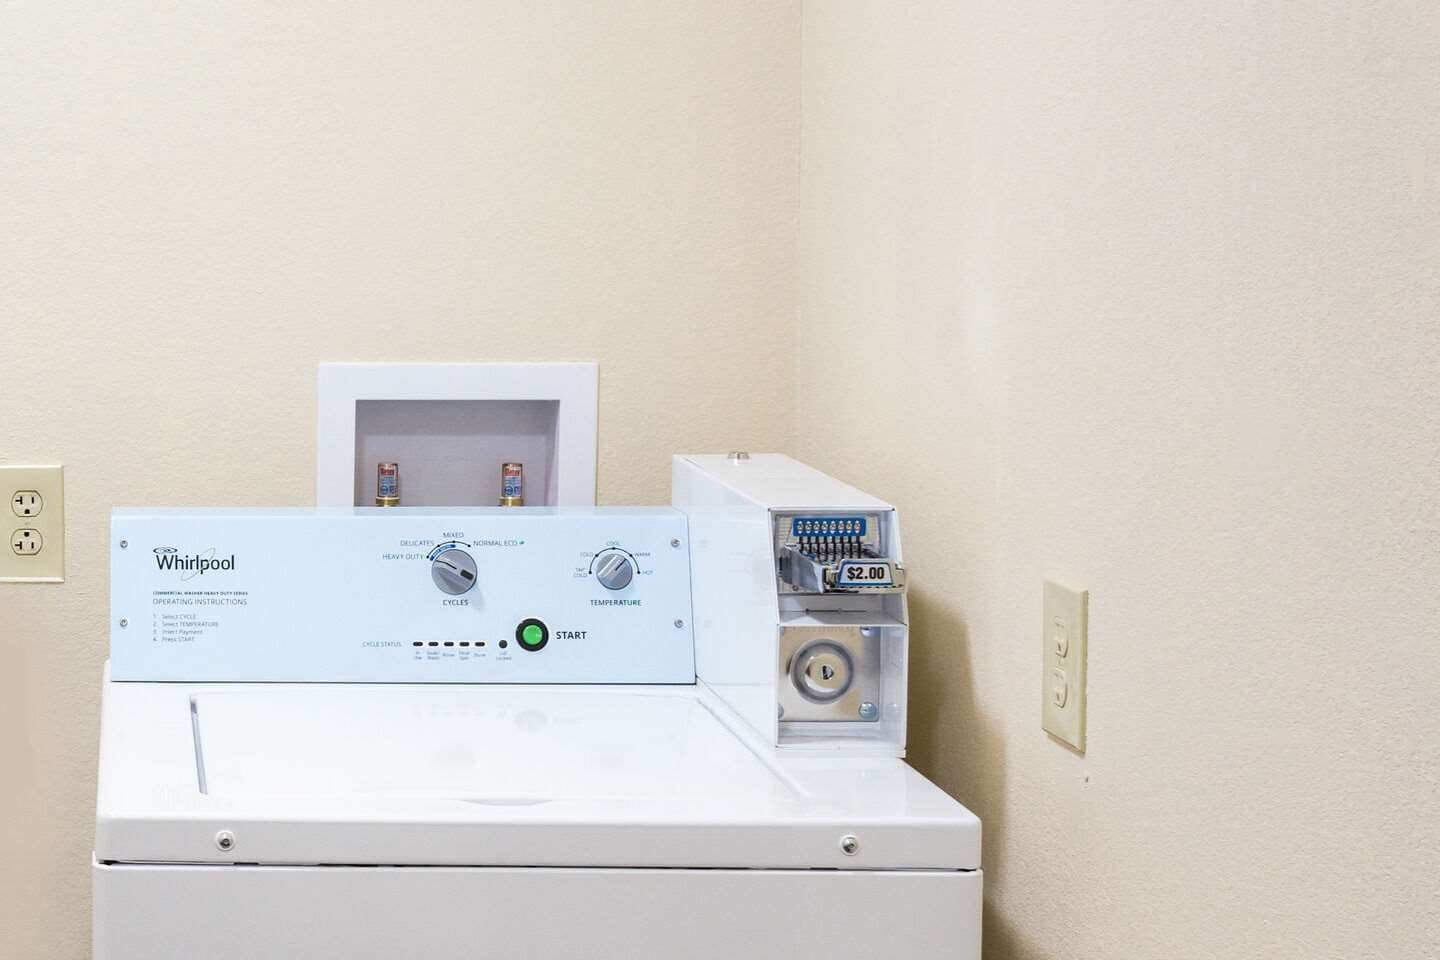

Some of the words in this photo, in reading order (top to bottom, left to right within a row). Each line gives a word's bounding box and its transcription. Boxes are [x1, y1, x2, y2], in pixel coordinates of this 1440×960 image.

[155, 554, 235, 575] Whirlpool
[847, 566, 885, 581] $2.00
[152, 598, 193, 606] OPERATING
[194, 598, 248, 606] INSTRUCTIONS
[555, 630, 588, 640] START
